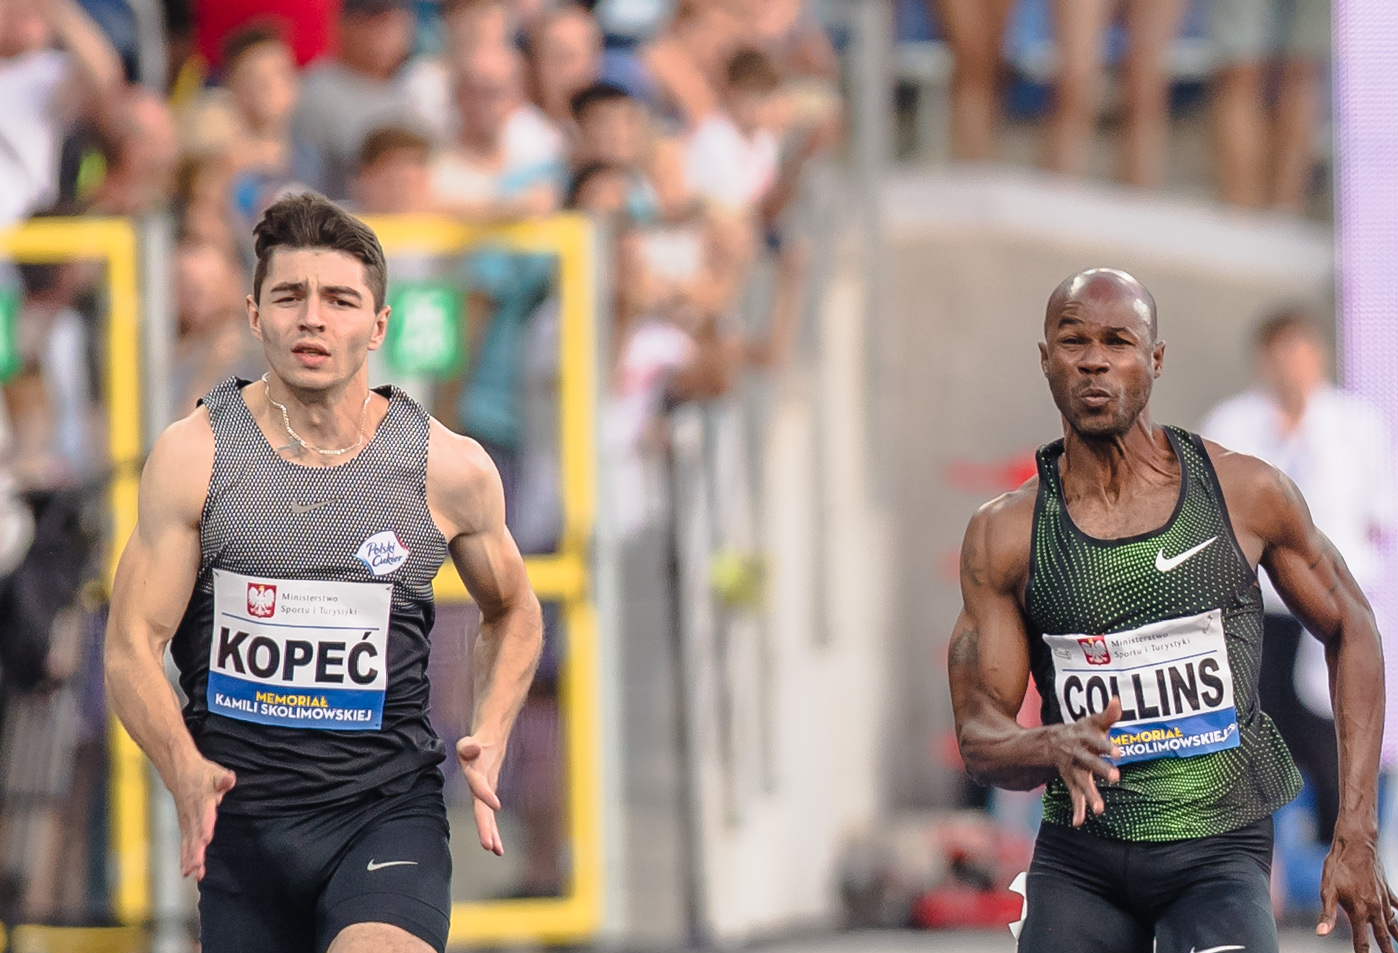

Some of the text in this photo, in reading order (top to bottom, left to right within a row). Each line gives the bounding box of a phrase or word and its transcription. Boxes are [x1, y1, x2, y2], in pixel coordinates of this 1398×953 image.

[366, 541, 395, 557] Polski
[372, 553, 402, 567] Cukier
[281, 592, 339, 603] Ministerstwo
[281, 605, 310, 615] Sportu
[319, 607, 358, 617] Turystyki
[1111, 632, 1169, 647] Ministerstwo
[1114, 649, 1142, 659] Sportu
[1151, 637, 1191, 652] Turystyki
[217, 626, 378, 685] KOPEĆ
[1063, 657, 1224, 723] COLLINS
[215, 693, 372, 722] KAMILI SKOLIMOWSKIEJ
[255, 691, 329, 708] MEMORIAŁ
[1109, 727, 1184, 746] MEMORIAŁ
[1119, 730, 1229, 757] SKOLIMOWSKIEJ
